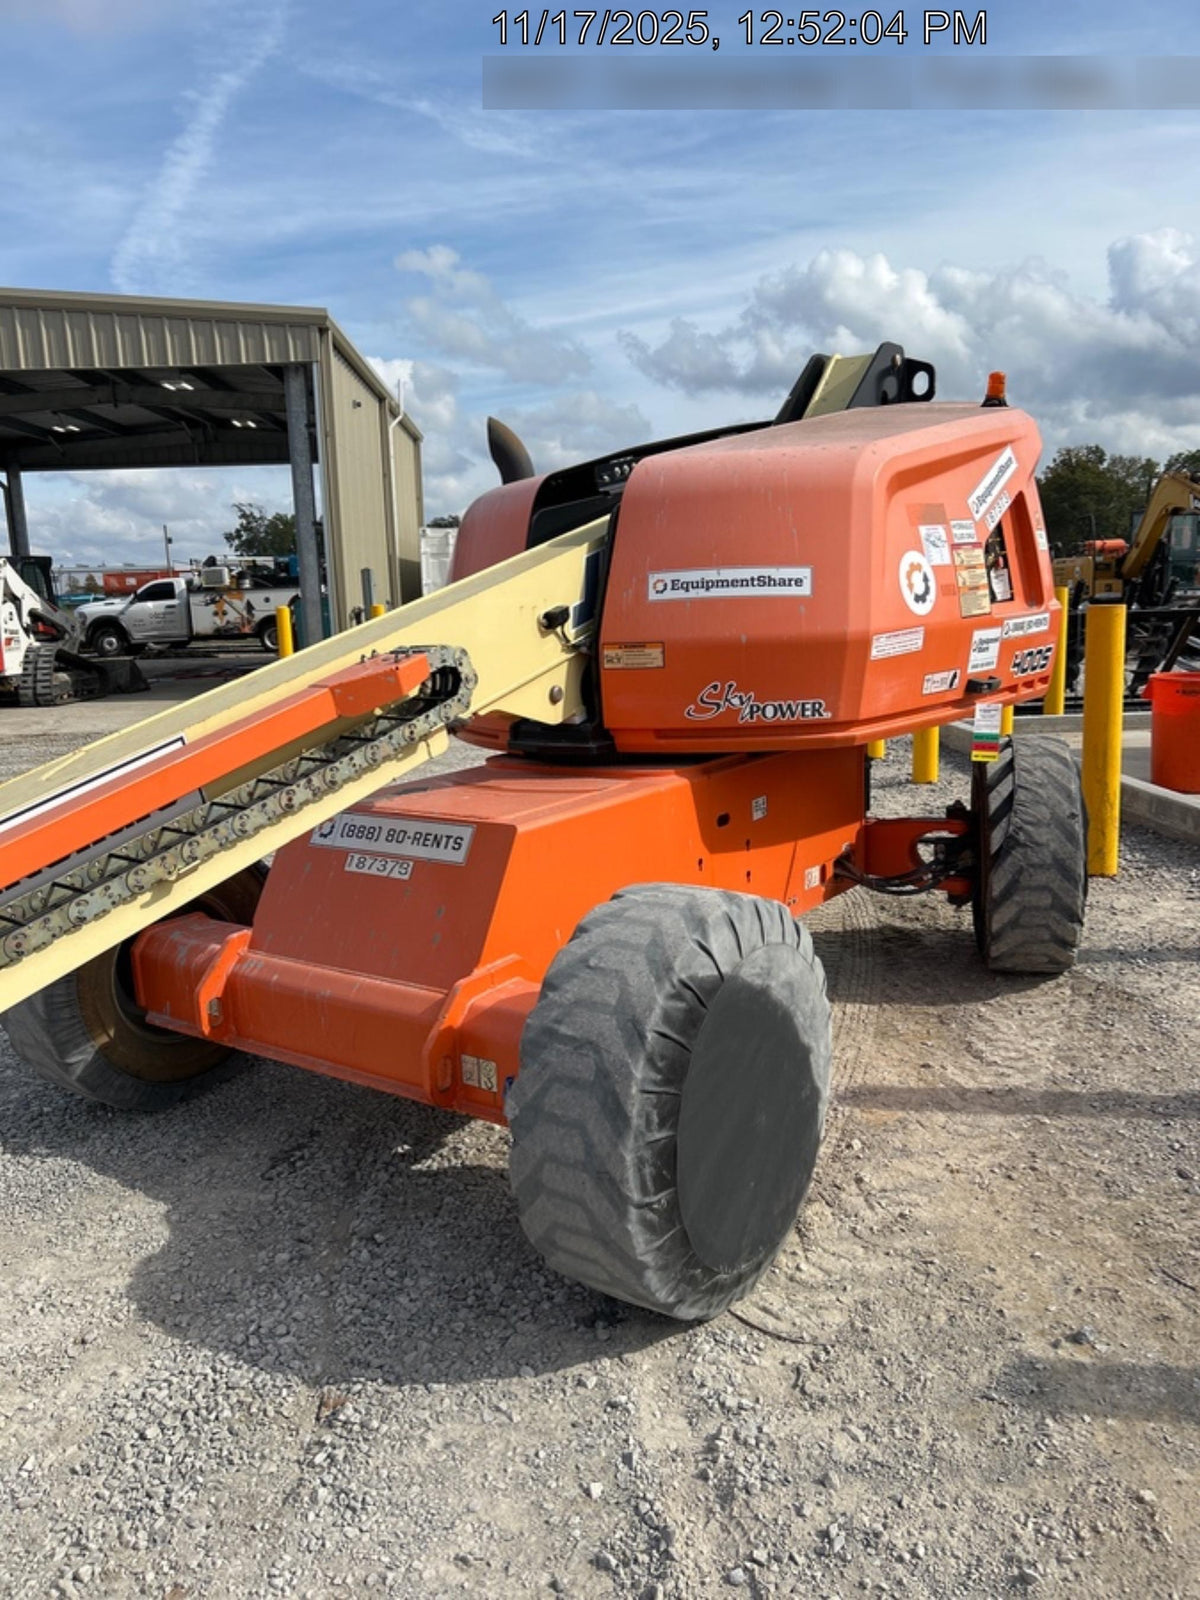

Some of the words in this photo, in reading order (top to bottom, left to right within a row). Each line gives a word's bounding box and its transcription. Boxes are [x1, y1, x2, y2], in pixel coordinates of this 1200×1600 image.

[670, 575, 804, 594] EquipmentShare
[340, 822, 383, 842] (888)
[385, 827, 464, 852] 80-RENTS
